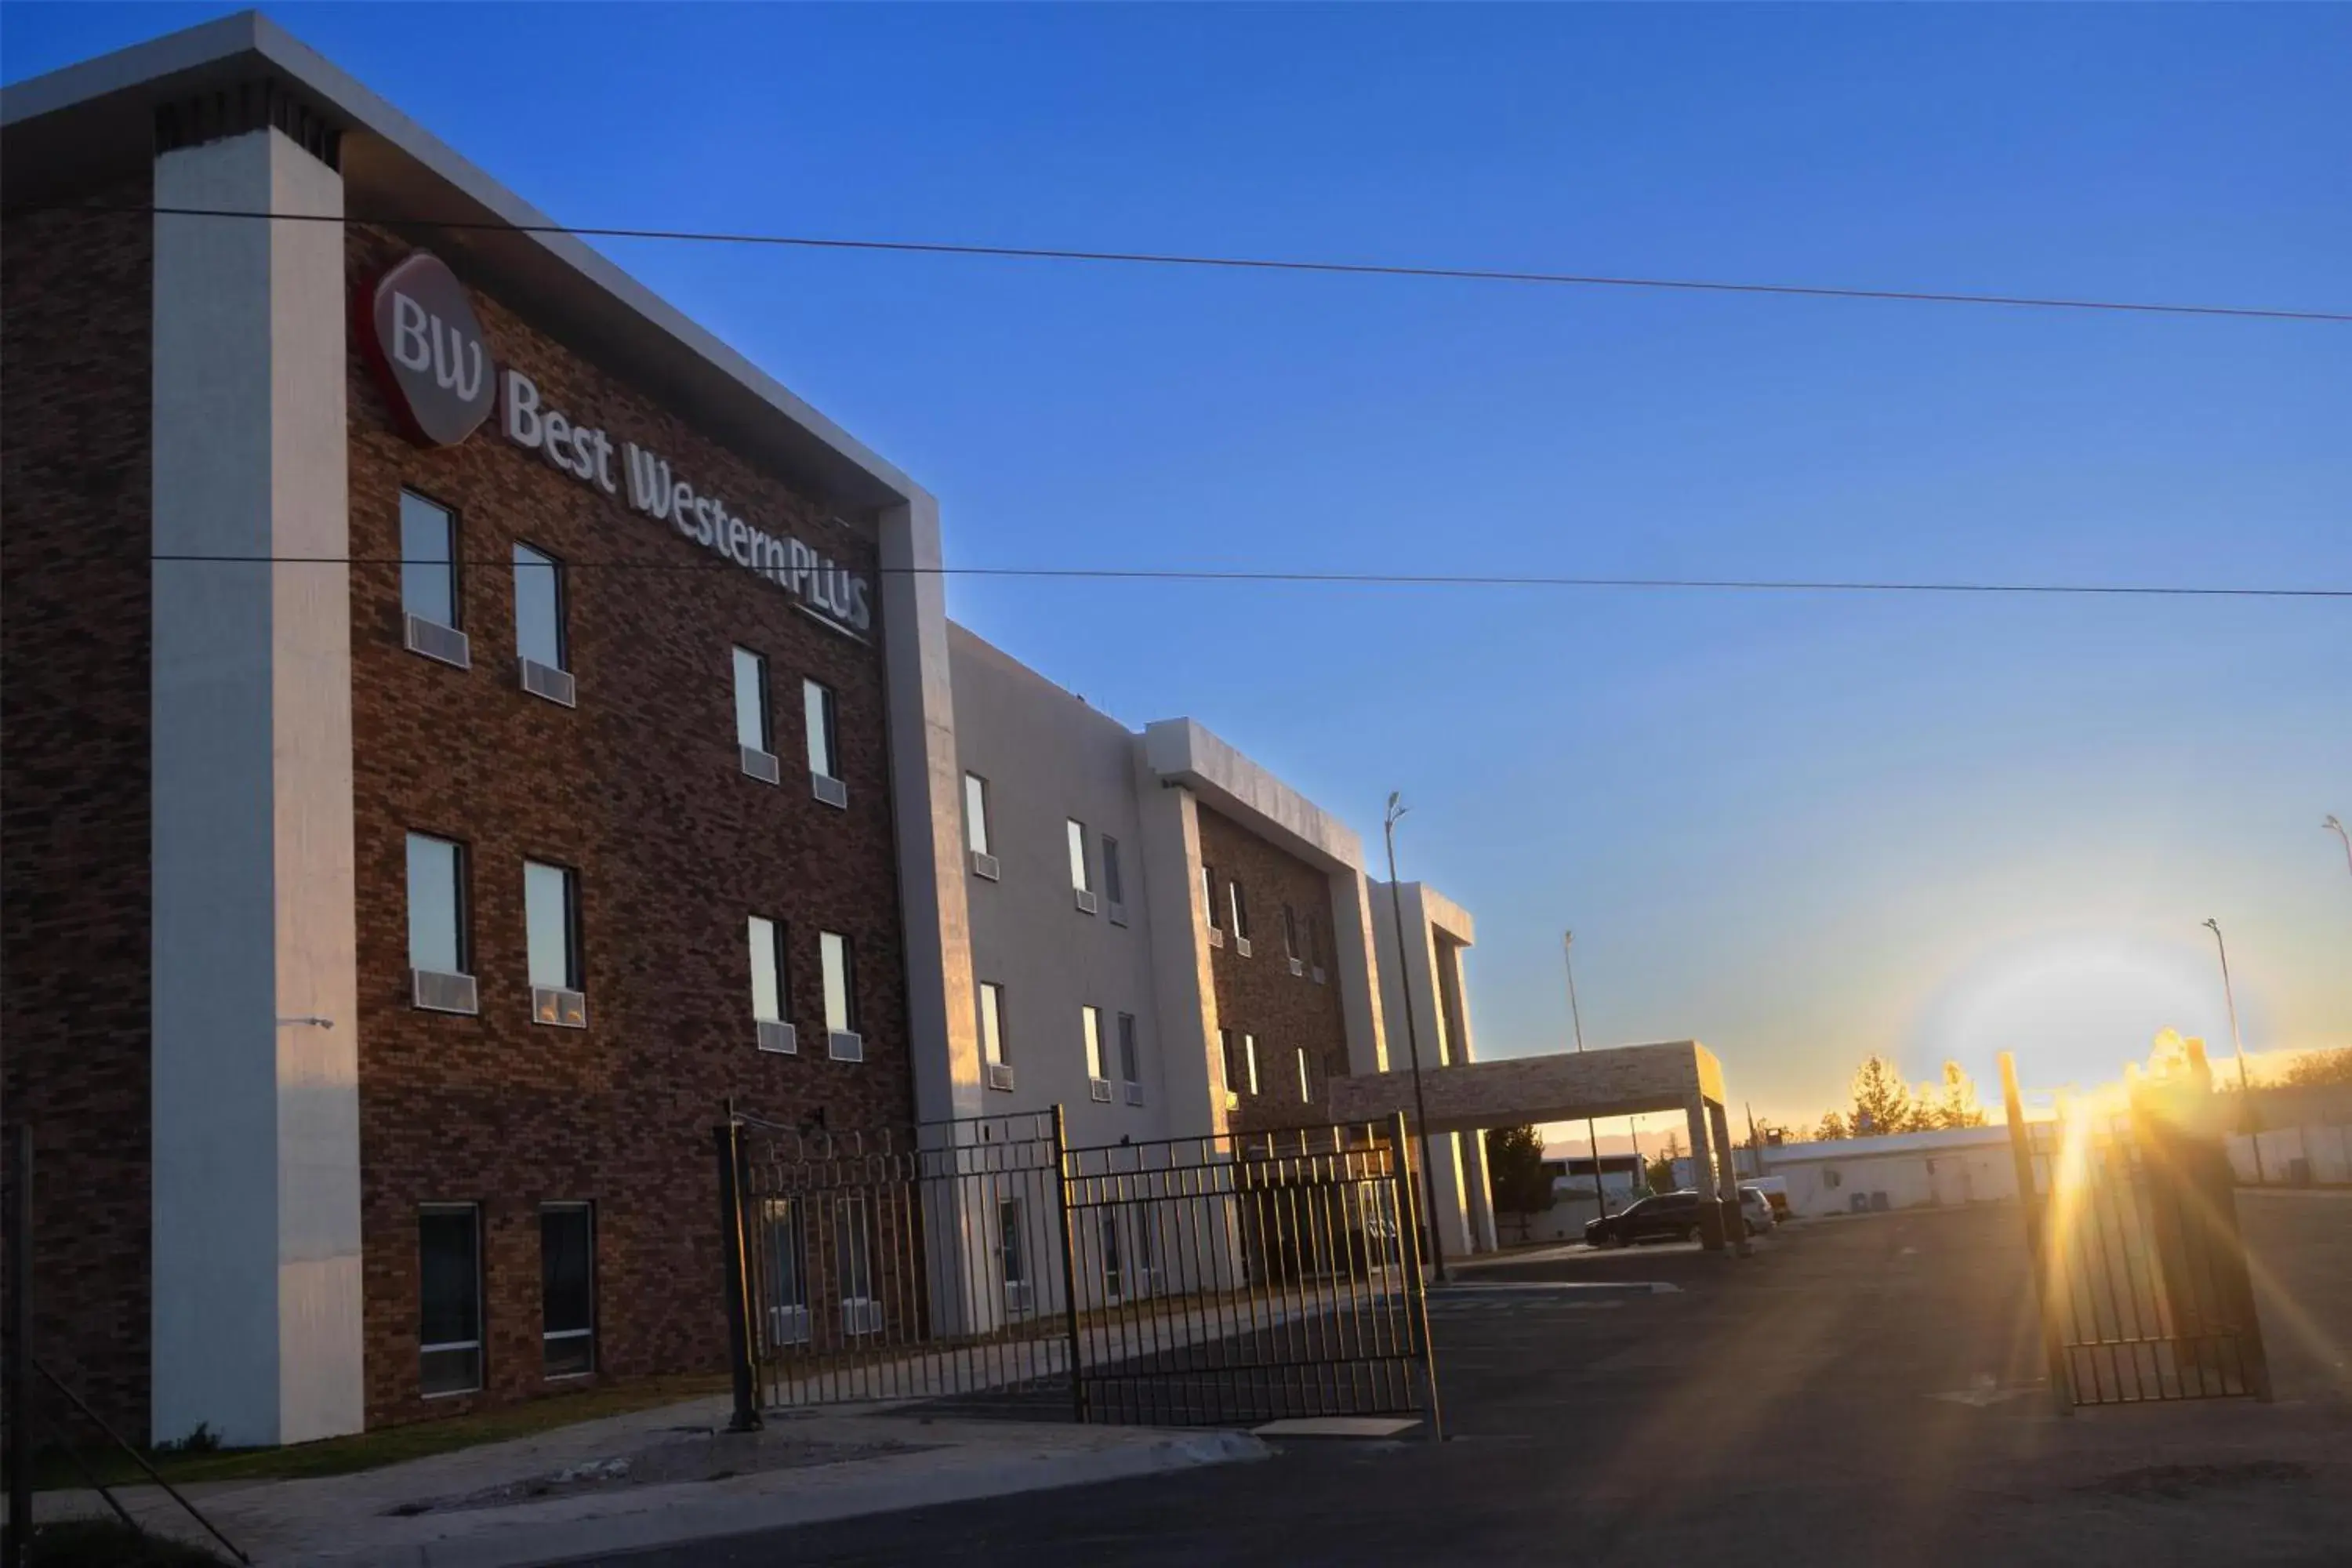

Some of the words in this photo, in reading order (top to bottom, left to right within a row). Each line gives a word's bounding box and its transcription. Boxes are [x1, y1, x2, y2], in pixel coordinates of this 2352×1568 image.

[394, 291, 483, 401] BW
[503, 368, 617, 494] Best
[626, 441, 787, 588] Western
